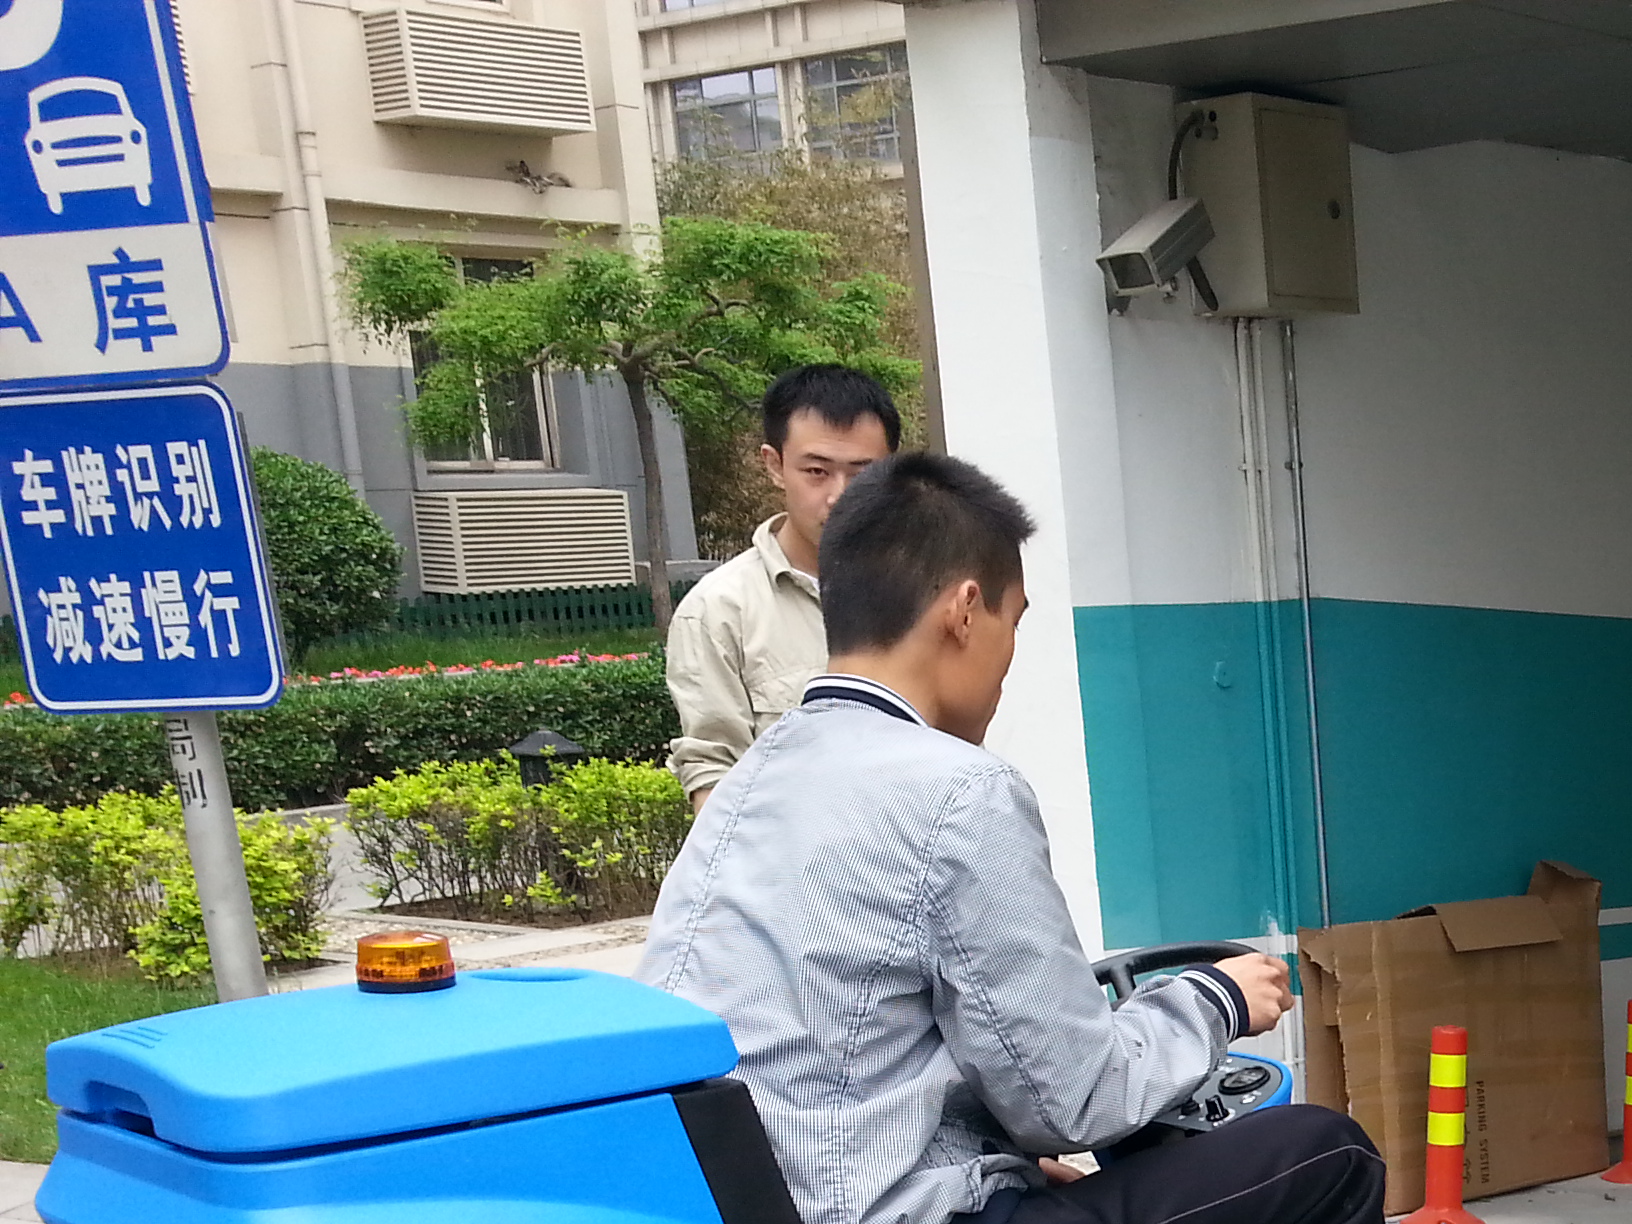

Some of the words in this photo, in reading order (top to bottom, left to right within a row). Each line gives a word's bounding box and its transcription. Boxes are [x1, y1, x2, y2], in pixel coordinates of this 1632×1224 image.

[87, 246, 178, 355] 库
[12, 438, 222, 539] 车牌识别
[37, 568, 242, 666] 减速慢行
[1476, 1080, 1487, 1132] PARKING
[1480, 1138, 1490, 1184] SYSTEM
